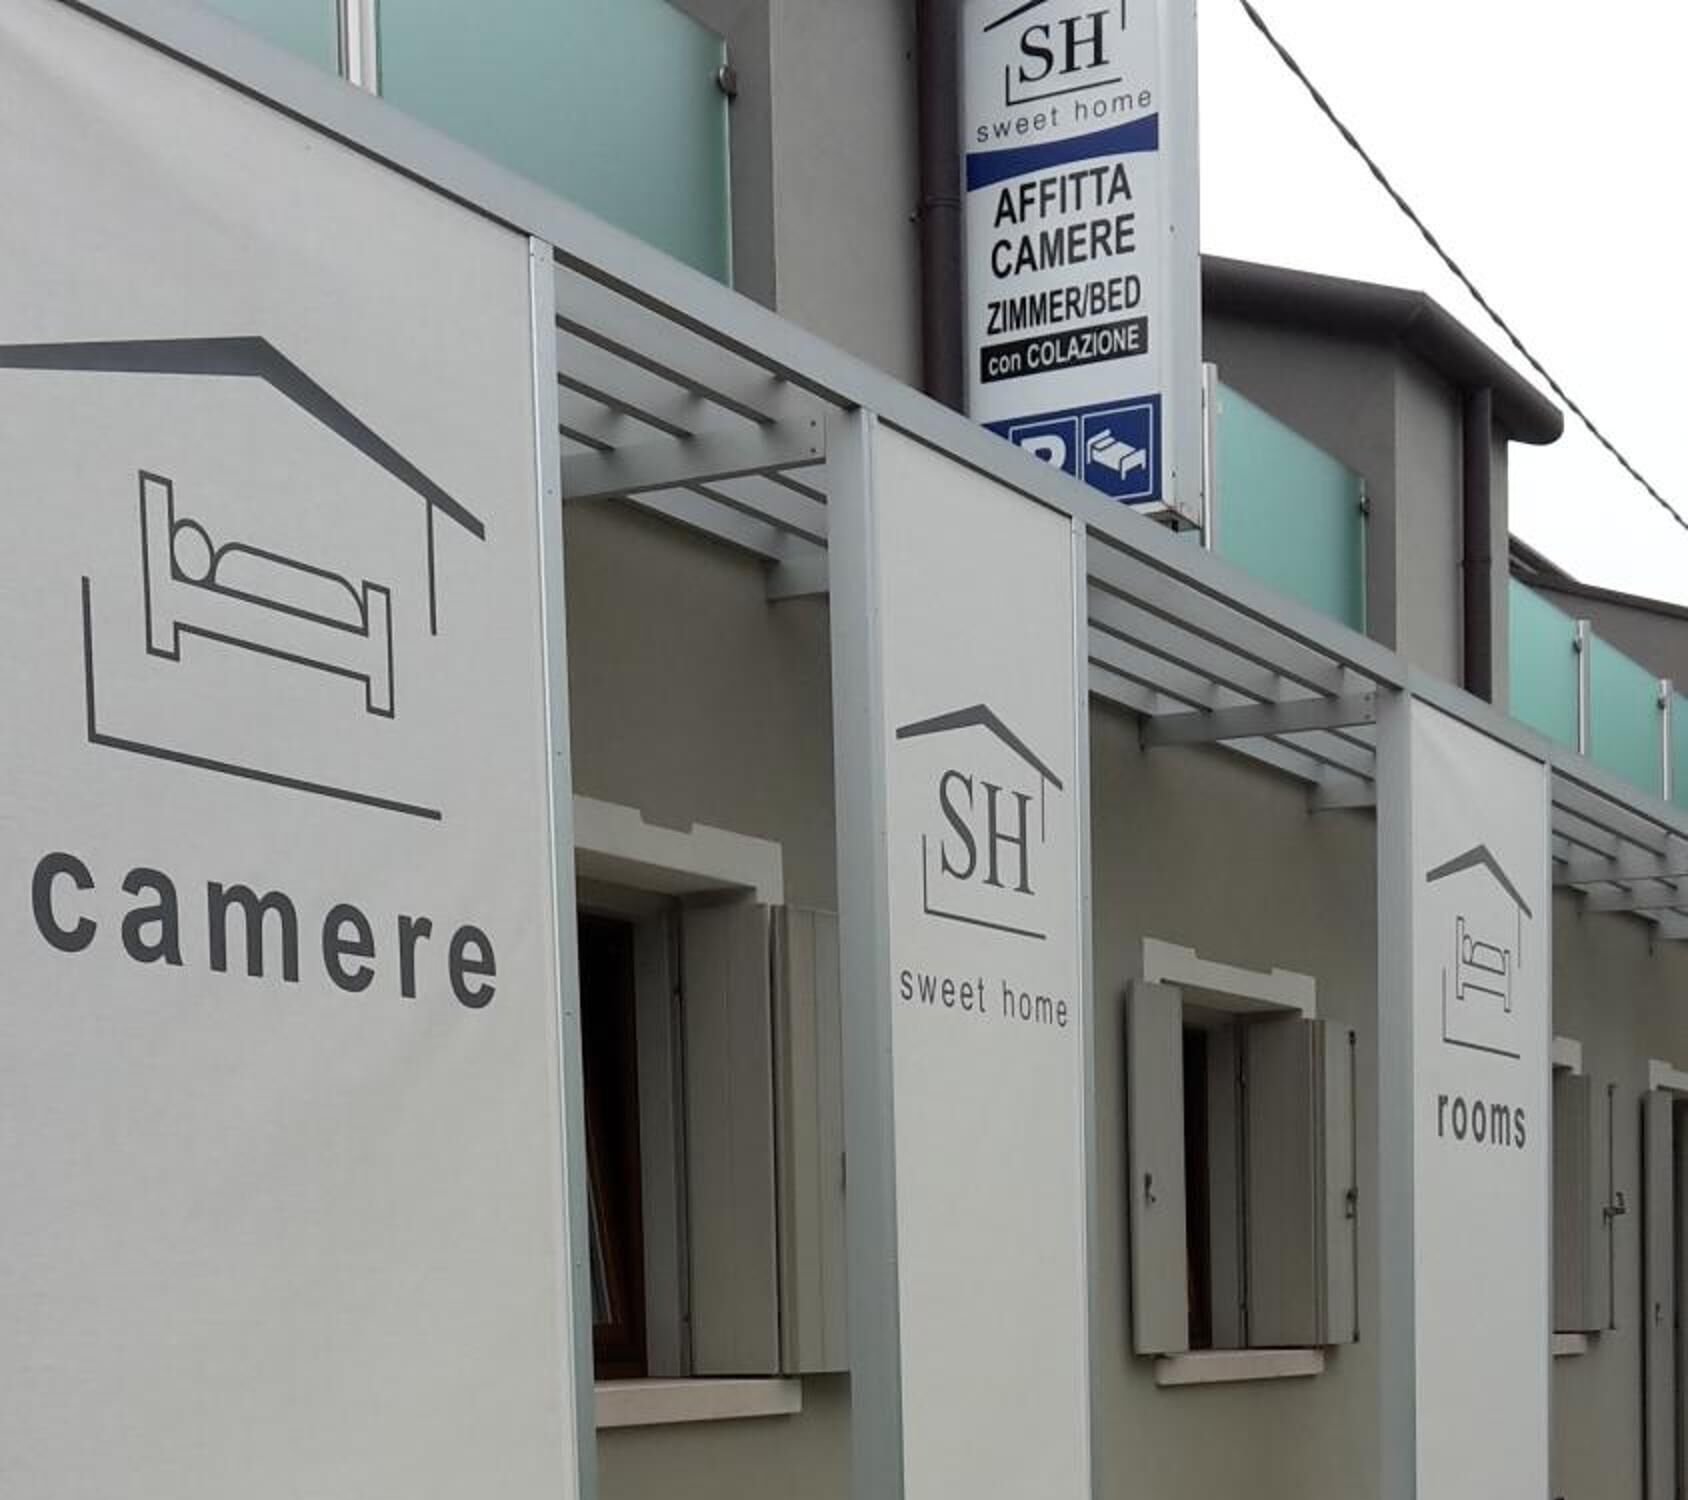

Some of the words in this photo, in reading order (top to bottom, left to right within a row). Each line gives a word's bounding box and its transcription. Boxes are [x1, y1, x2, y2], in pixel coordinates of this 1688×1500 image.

[1018, 10, 1110, 84] SH
[976, 107, 1058, 143] sweet
[1074, 90, 1153, 122] home
[994, 162, 1133, 228] AFFITTA
[991, 213, 1136, 279] CAMERE
[987, 274, 1141, 335] ZIMMER/BED
[988, 353, 1022, 376] con
[1027, 324, 1140, 368] COLAZIONE
[939, 769, 1035, 895] SH
[31, 851, 497, 1010] camere
[900, 969, 986, 1014] sweet
[1001, 979, 1068, 1028] home
[1438, 1094, 1526, 1149] rooms
